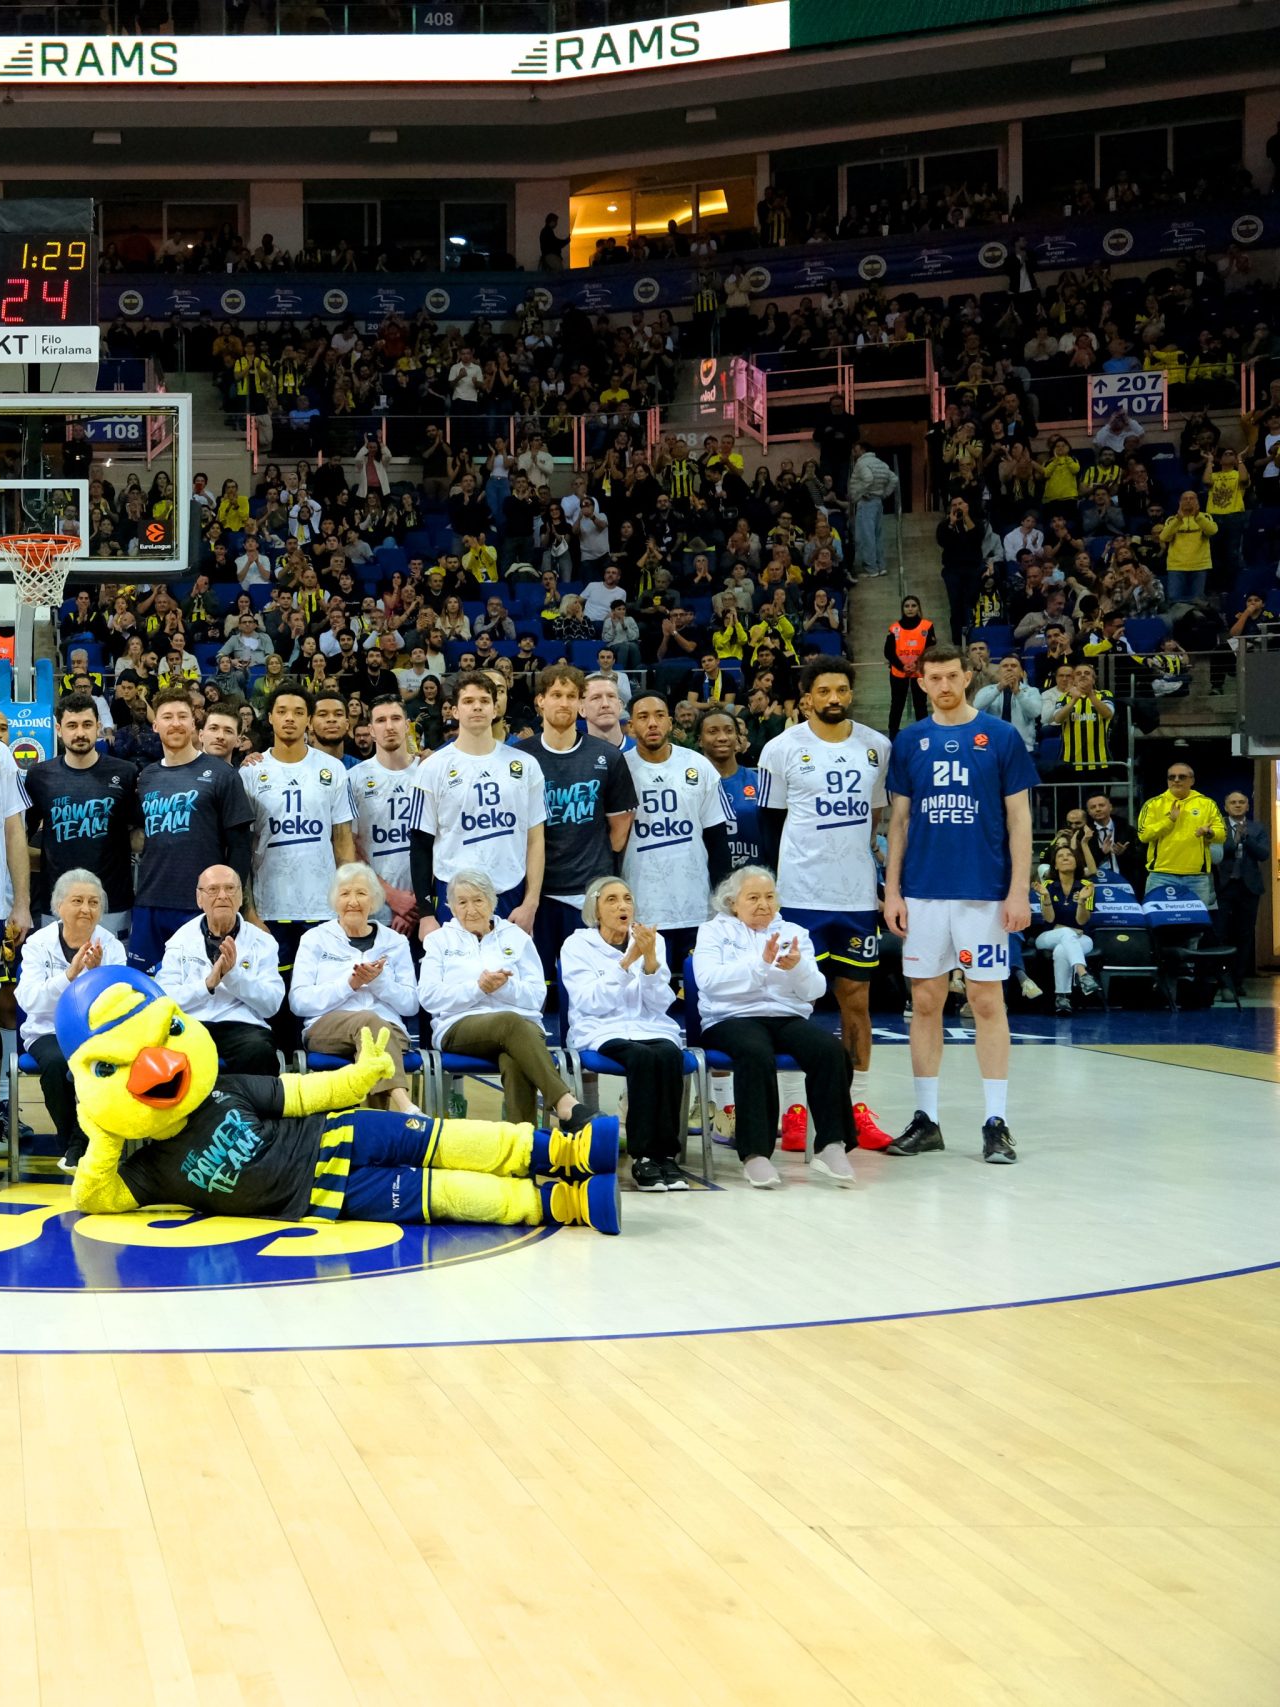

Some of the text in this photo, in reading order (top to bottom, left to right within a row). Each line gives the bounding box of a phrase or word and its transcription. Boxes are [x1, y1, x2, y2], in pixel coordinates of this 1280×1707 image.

[423, 12, 454, 26] 408
[555, 20, 700, 73] RAMS
[40, 41, 178, 77] RAMS
[21, 241, 87, 271] 1:29
[0, 278, 69, 322] 24
[42, 335, 62, 344] Filo
[42, 345, 92, 355] Kiralama
[1116, 374, 1162, 393] 207
[1119, 395, 1163, 413] 107
[102, 424, 139, 439] 108
[7, 716, 52, 728] PALDING
[826, 770, 862, 794] 92
[933, 760, 969, 786] 24
[284, 789, 303, 813] 11
[473, 782, 501, 807] 13
[545, 780, 601, 806] OWER
[642, 788, 678, 813] 50
[386, 797, 411, 821] 12
[815, 796, 870, 818] beko
[929, 809, 974, 824] EFES
[52, 816, 109, 843] TEAM
[143, 808, 192, 838] TEAM
[268, 815, 323, 836] beko
[461, 808, 517, 831] beko
[634, 817, 693, 840] beko
[372, 824, 411, 844] bek
[727, 842, 759, 859] DOLU
[862, 935, 879, 958] 9
[978, 944, 1006, 967] 24
[208, 1122, 264, 1193] TEAM
[392, 1192, 401, 1209] YKT
